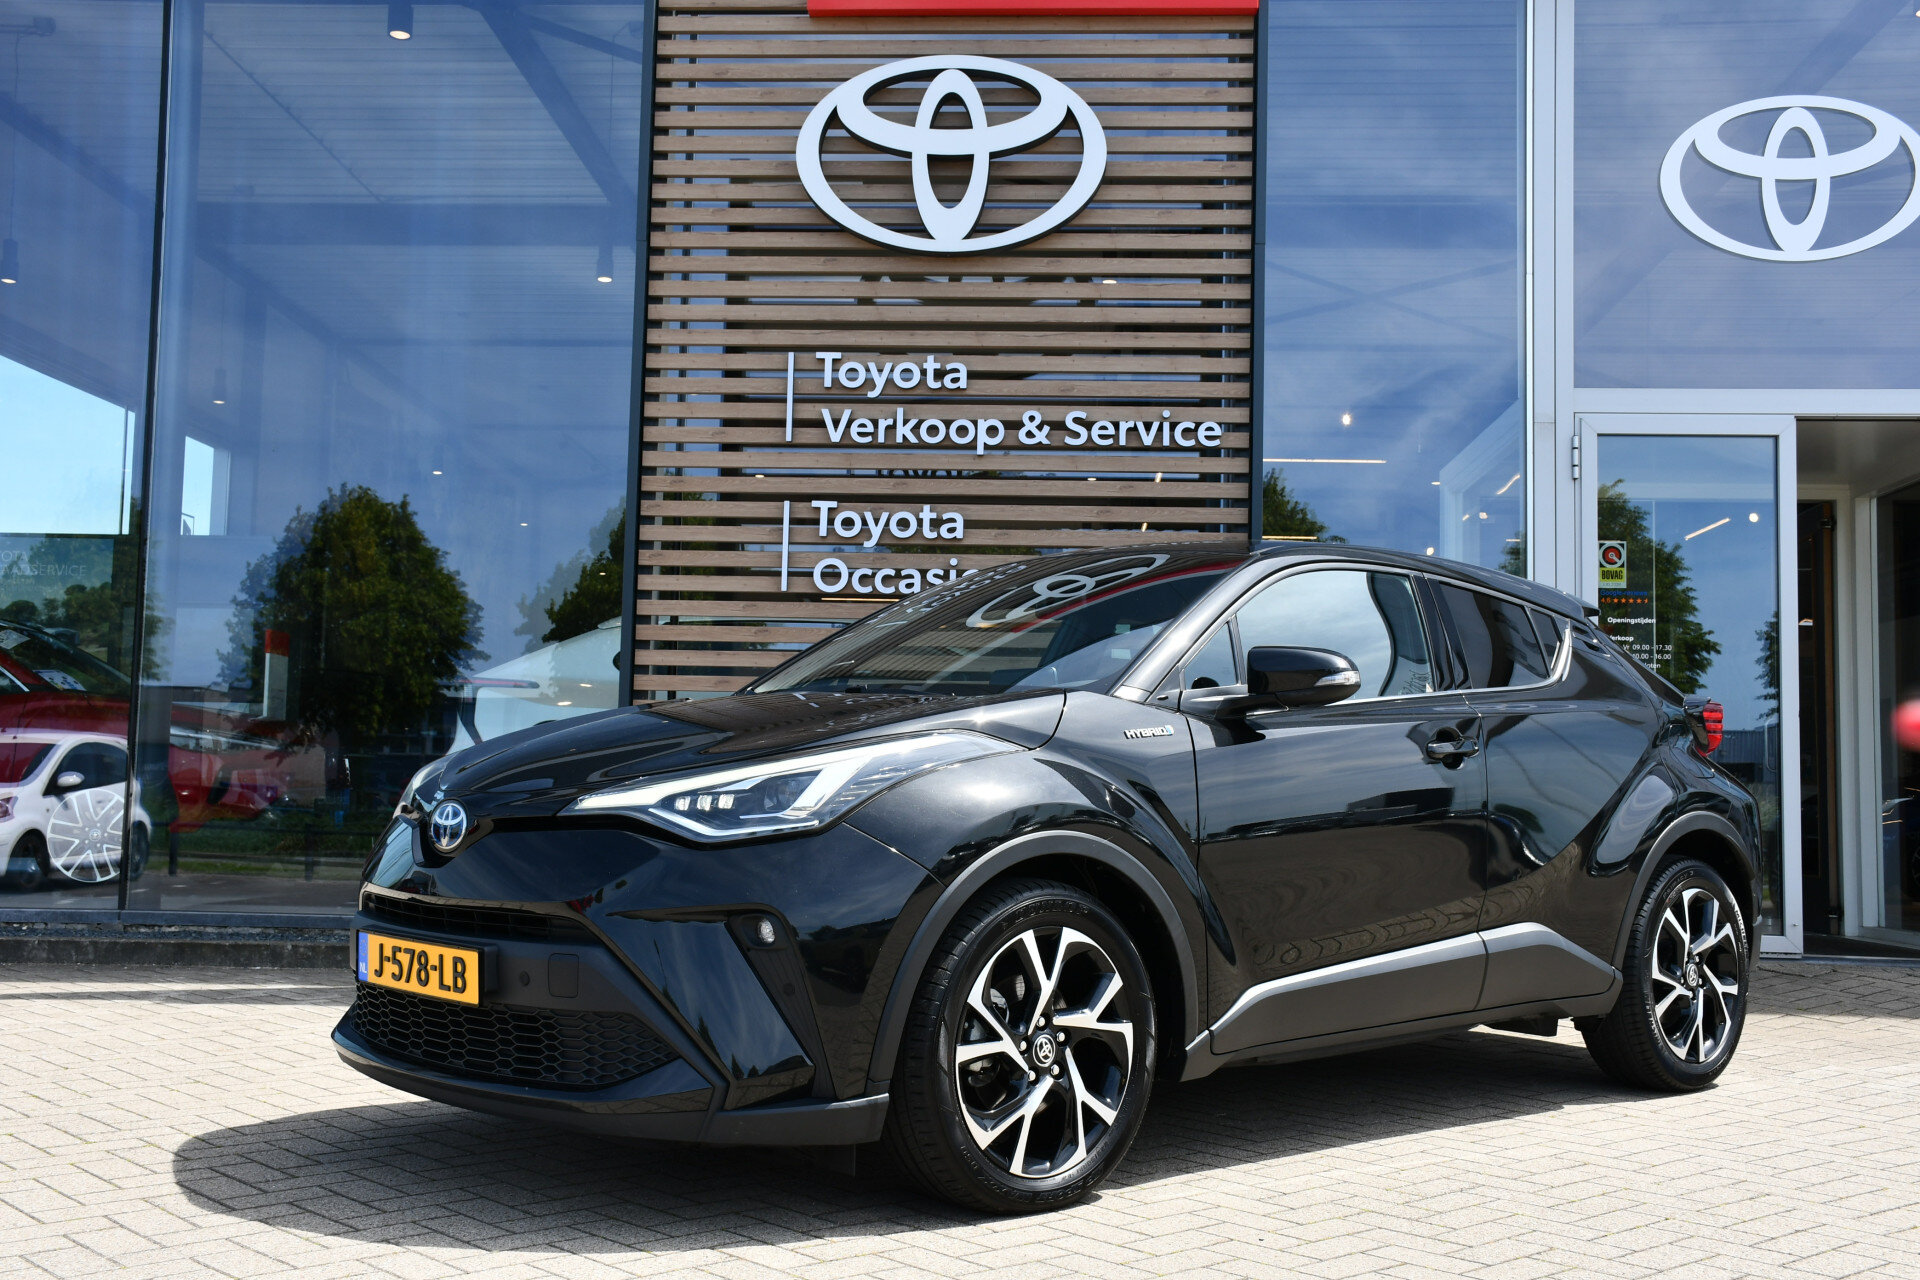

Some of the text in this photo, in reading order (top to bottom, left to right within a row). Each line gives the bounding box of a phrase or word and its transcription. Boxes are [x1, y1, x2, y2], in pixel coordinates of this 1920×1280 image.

[816, 351, 968, 398] Toyota
[821, 407, 1223, 455] Verkoop & Service
[811, 500, 965, 548] Toyota
[813, 557, 979, 594] Occasi
[1601, 569, 1624, 580] BOVAG
[1607, 616, 1656, 625] Openingstijden
[1124, 727, 1168, 739] HYBRID
[359, 962, 368, 974] NL
[374, 943, 467, 994] J-578-LB
